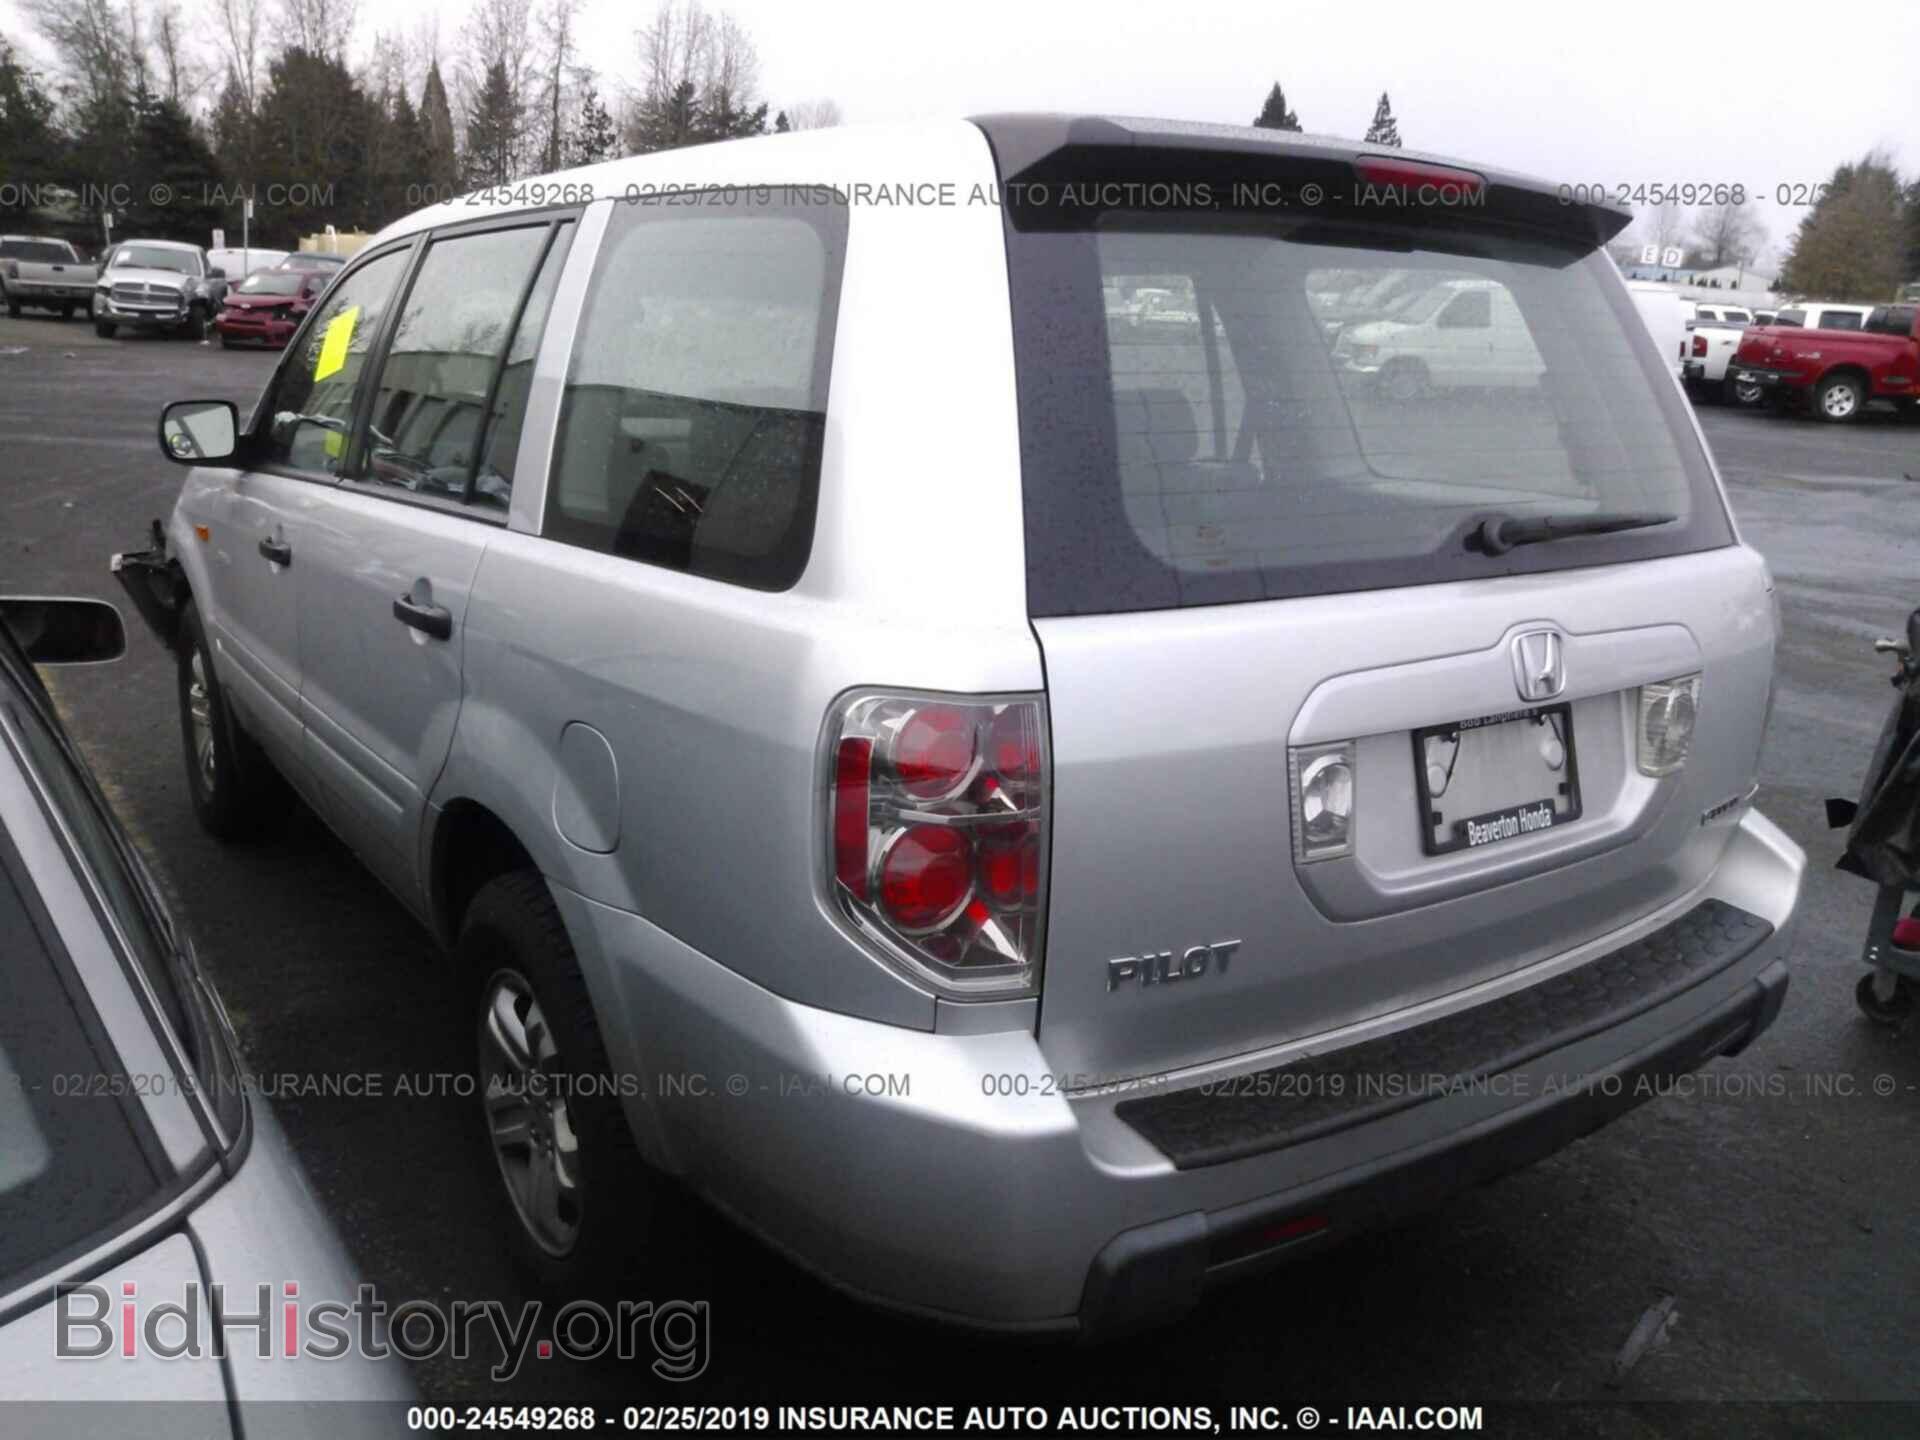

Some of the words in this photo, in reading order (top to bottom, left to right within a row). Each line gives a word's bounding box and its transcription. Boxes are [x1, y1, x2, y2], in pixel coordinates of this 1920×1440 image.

[1467, 814, 1519, 846] Beaverton
[1519, 803, 1552, 832] Honda
[1106, 939, 1242, 992] PILOT
